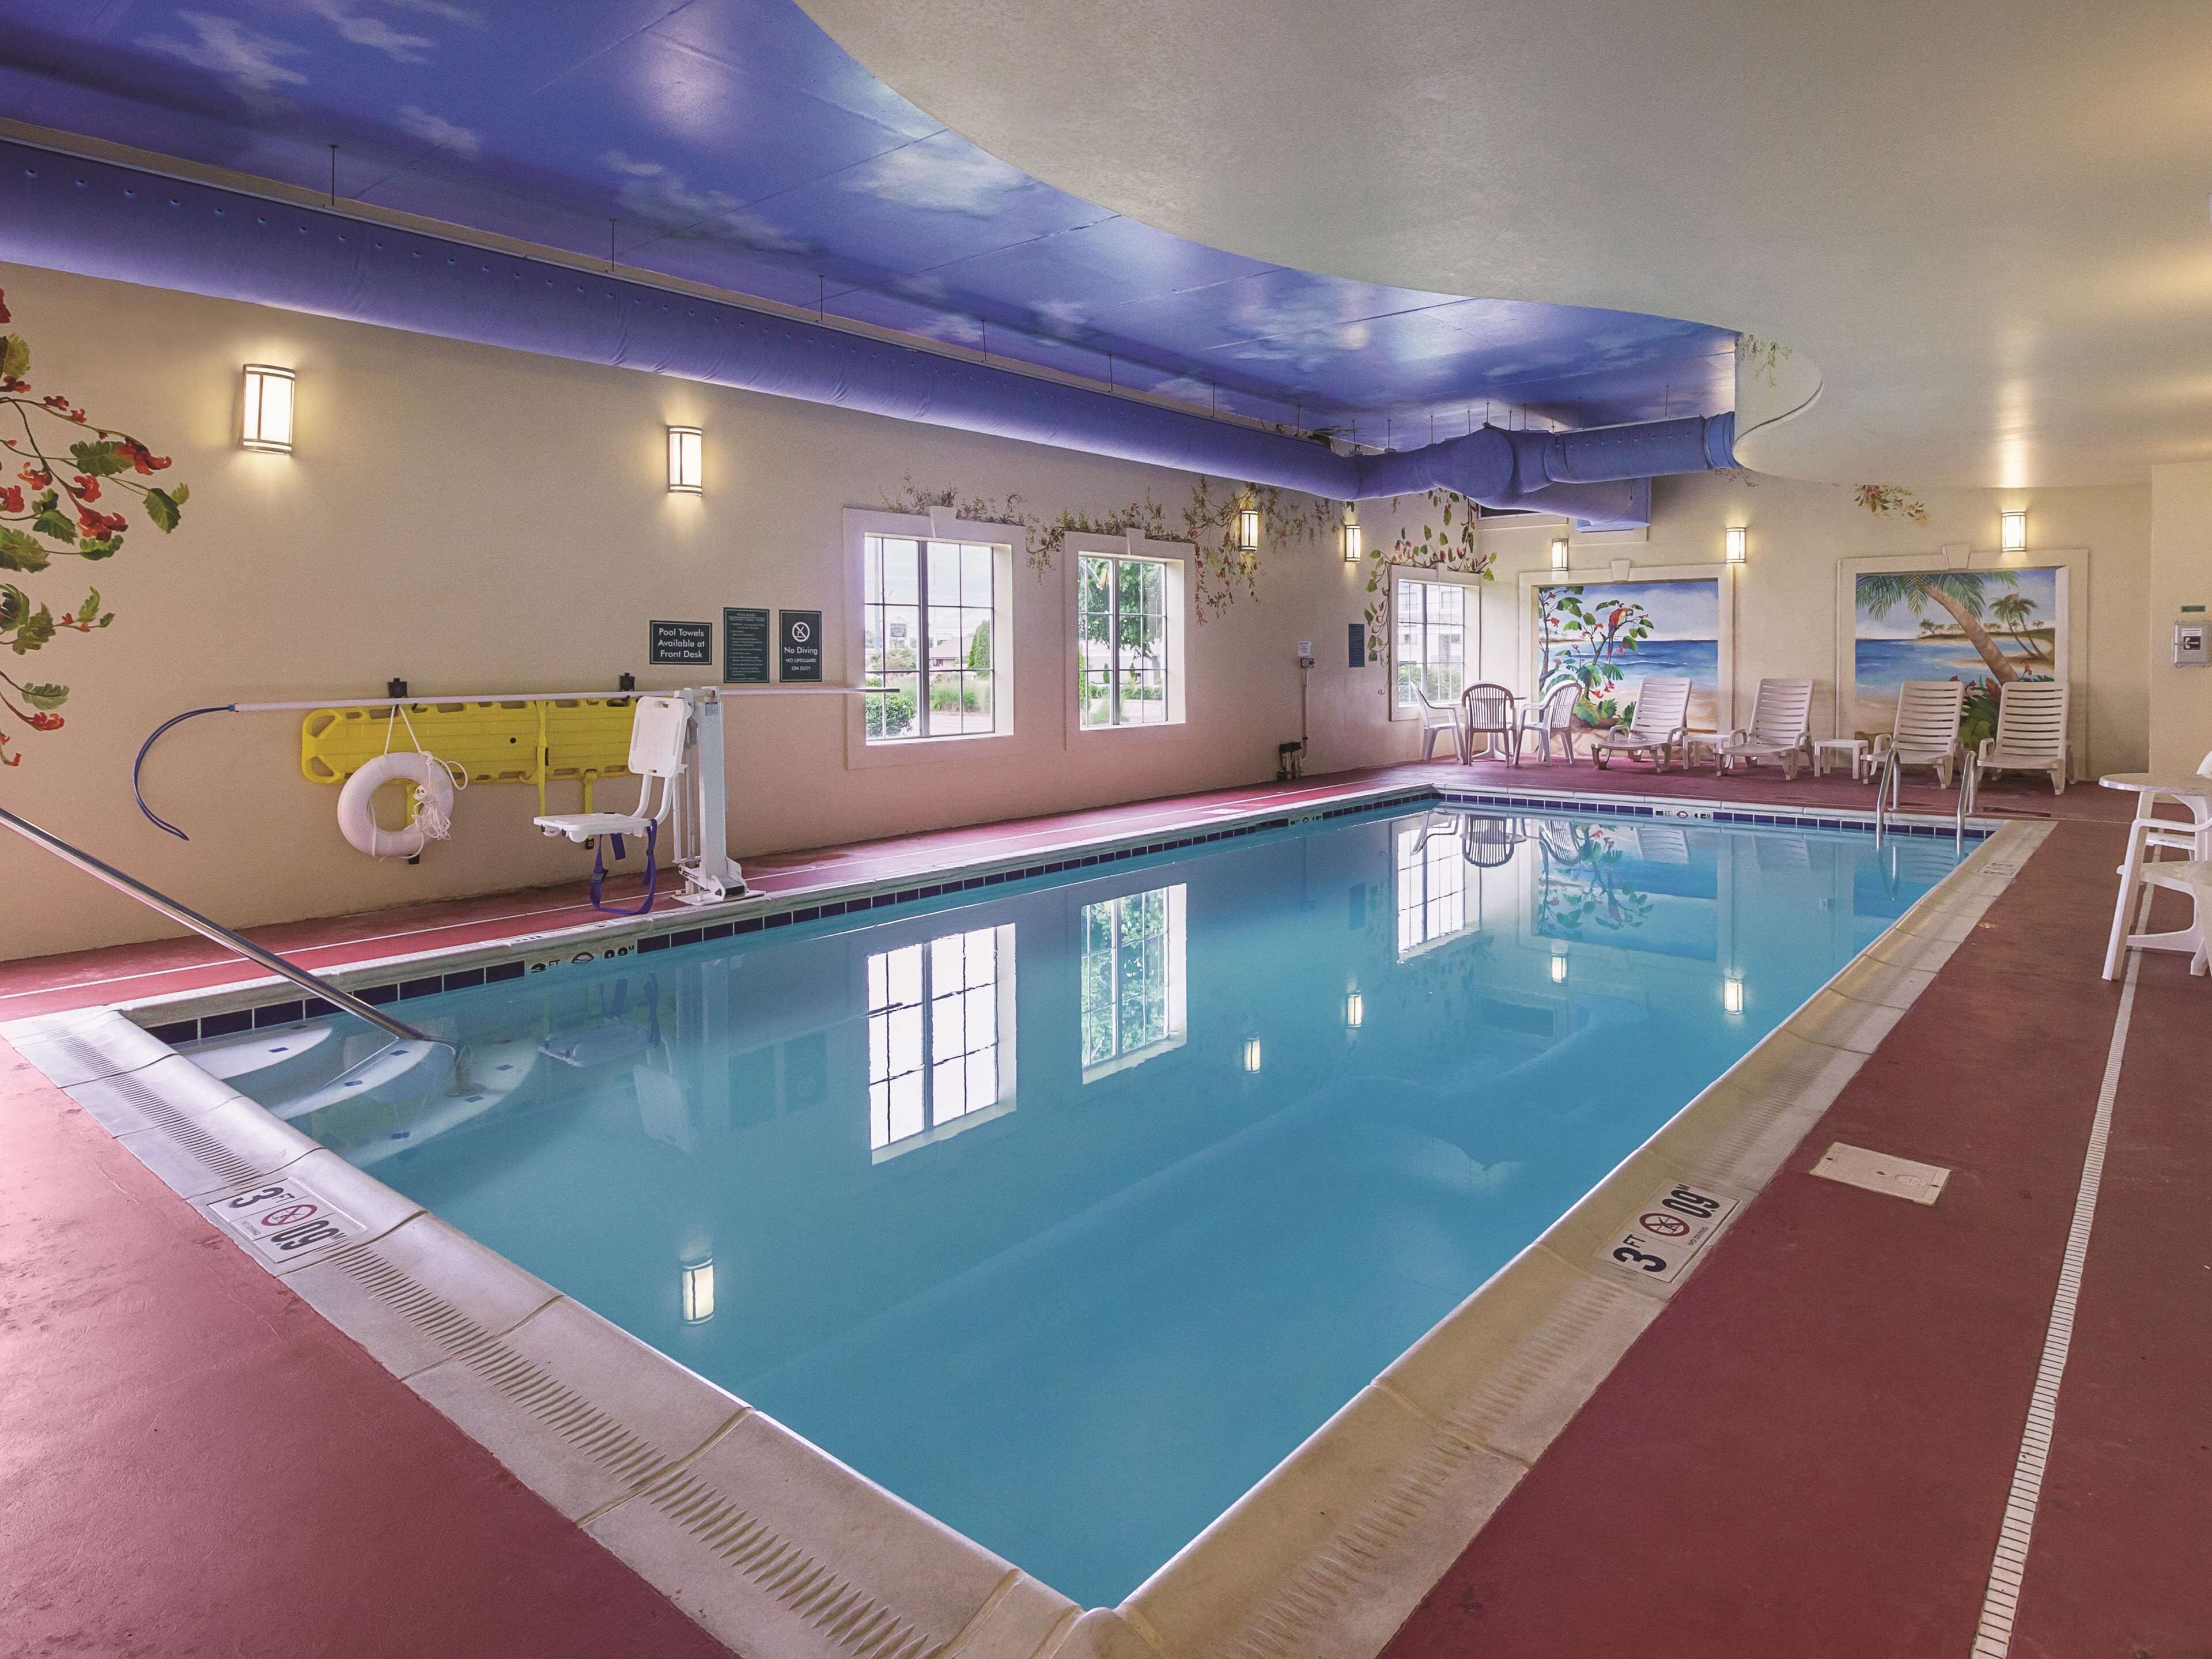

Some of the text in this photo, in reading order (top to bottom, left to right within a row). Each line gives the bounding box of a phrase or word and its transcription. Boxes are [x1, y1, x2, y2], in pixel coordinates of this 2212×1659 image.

[678, 629, 704, 637] Towels
[683, 650, 703, 658] Desk
[797, 647, 818, 655] Diving
[229, 1187, 284, 1208] 3
[1693, 1226, 1709, 1240] DIVING
[1623, 1234, 1646, 1248] FT
[1613, 1246, 1667, 1272] 3
